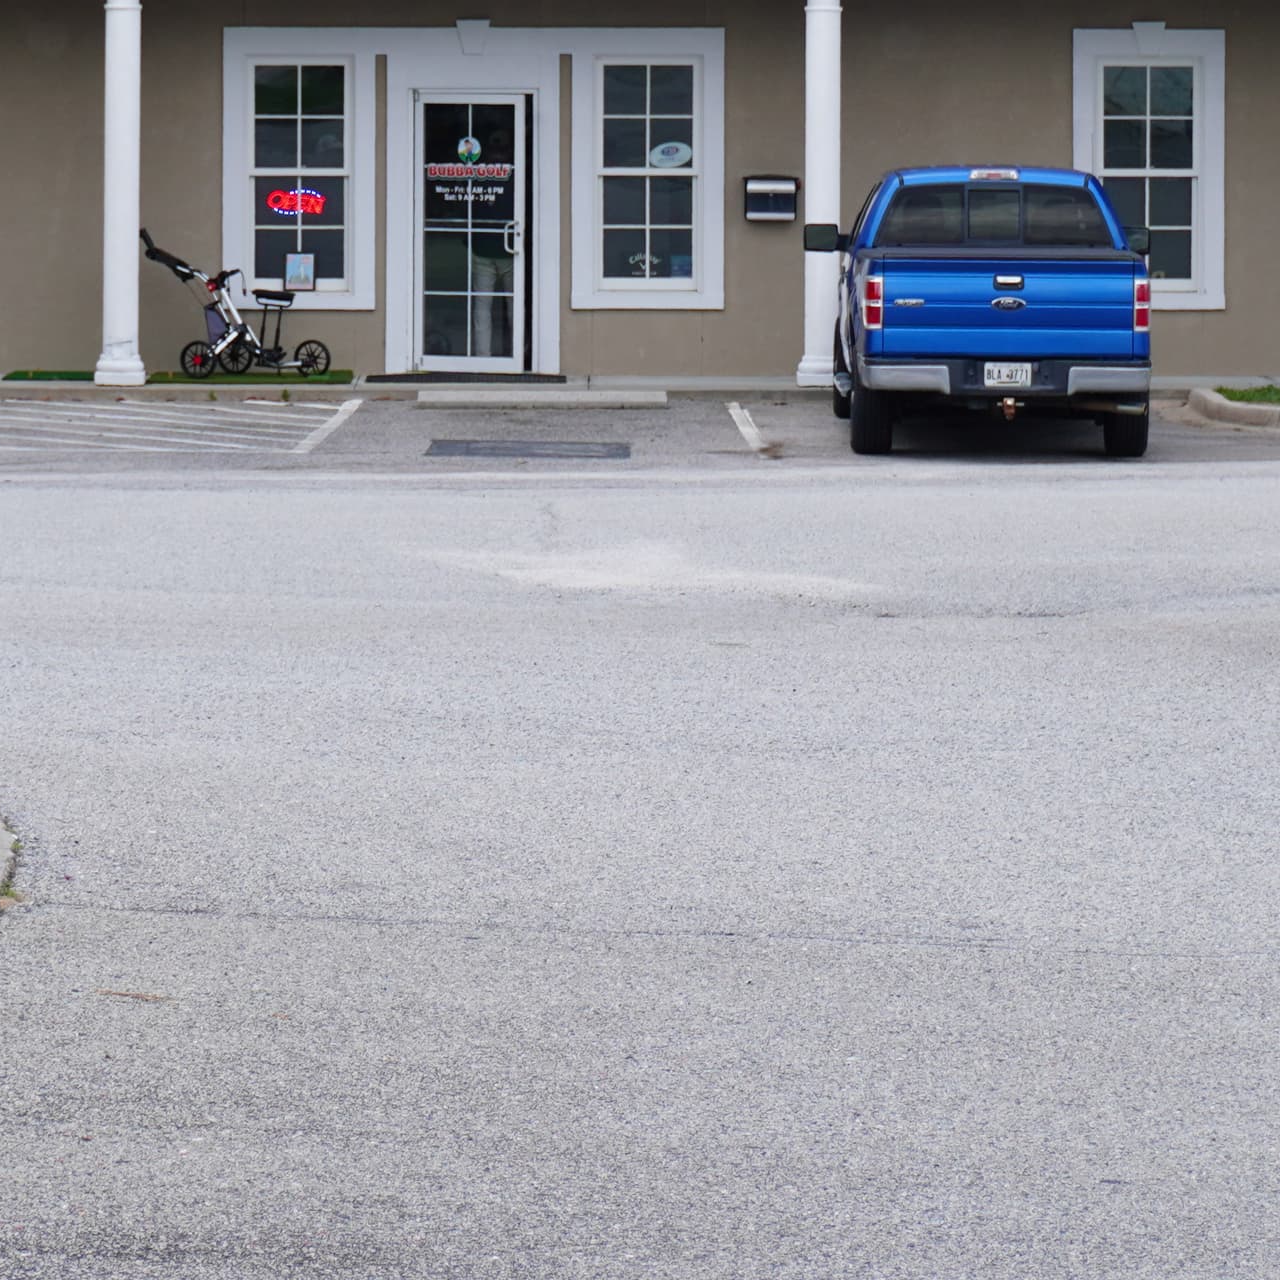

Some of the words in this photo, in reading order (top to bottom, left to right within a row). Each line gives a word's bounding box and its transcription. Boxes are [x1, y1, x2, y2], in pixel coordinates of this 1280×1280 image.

[428, 164, 475, 178] BUBBA
[476, 164, 511, 178] GOLF
[493, 186, 504, 194] PM
[266, 190, 327, 214] OPEN
